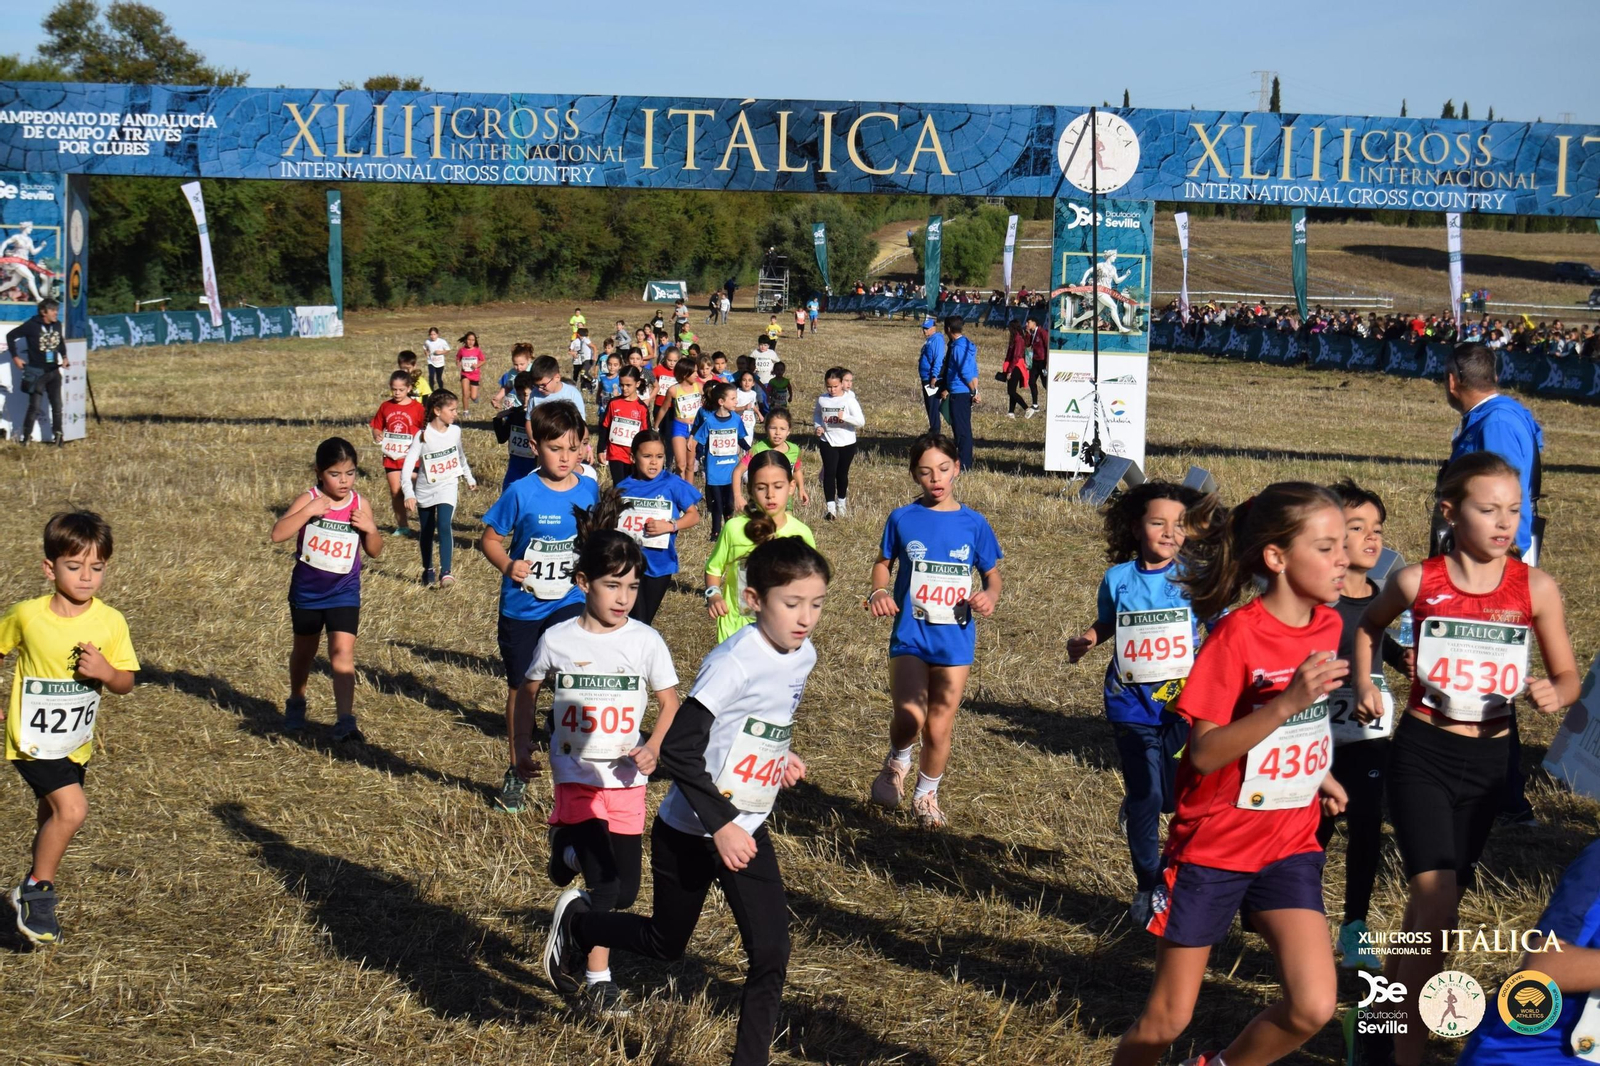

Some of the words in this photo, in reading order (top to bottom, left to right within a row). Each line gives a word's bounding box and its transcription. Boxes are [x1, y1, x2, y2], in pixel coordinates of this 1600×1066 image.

[100, 114, 120, 126] DE
[123, 111, 218, 128] ANDALUCÍA
[451, 107, 580, 140] CROSS
[23, 126, 44, 138] DE
[46, 126, 104, 140] CAMPO
[107, 128, 120, 140] A
[122, 126, 182, 142] TRAVÉS
[281, 103, 446, 159] XLIII
[639, 98, 956, 176] ITÁLICA
[58, 141, 90, 154] POR
[92, 142, 150, 155] CLUBES
[450, 143, 627, 163] INTERNACIONAL
[1186, 123, 1355, 183] XLIII
[1360, 130, 1492, 166] CROSS
[280, 162, 436, 180] INTERNATIONAL
[440, 164, 500, 182] CROSS
[503, 166, 596, 184] COUNTRY
[1360, 166, 1540, 190] INTERNACIONAL
[20, 190, 54, 200] Sevilla
[1184, 182, 1344, 204] INTERNATIONAL
[1348, 188, 1408, 206] CROSS
[1412, 190, 1506, 210] COUNTRY
[1105, 218, 1140, 228] Sevilla
[1106, 210, 1140, 219] Diputación
[384, 443, 410, 453] 4412
[712, 439, 736, 448] 4392
[430, 458, 458, 474] 4348
[308, 536, 352, 559] 4481
[916, 584, 966, 607] 4408
[1134, 613, 1169, 623] ITÁLICA
[1454, 624, 1505, 640] ITÁLICA
[1124, 636, 1187, 662] 4495
[579, 676, 622, 688] ITÁLICA
[1427, 657, 1518, 695] 4530
[30, 701, 95, 733] 4276
[561, 705, 635, 734] 4505
[1258, 735, 1329, 780] 4368
